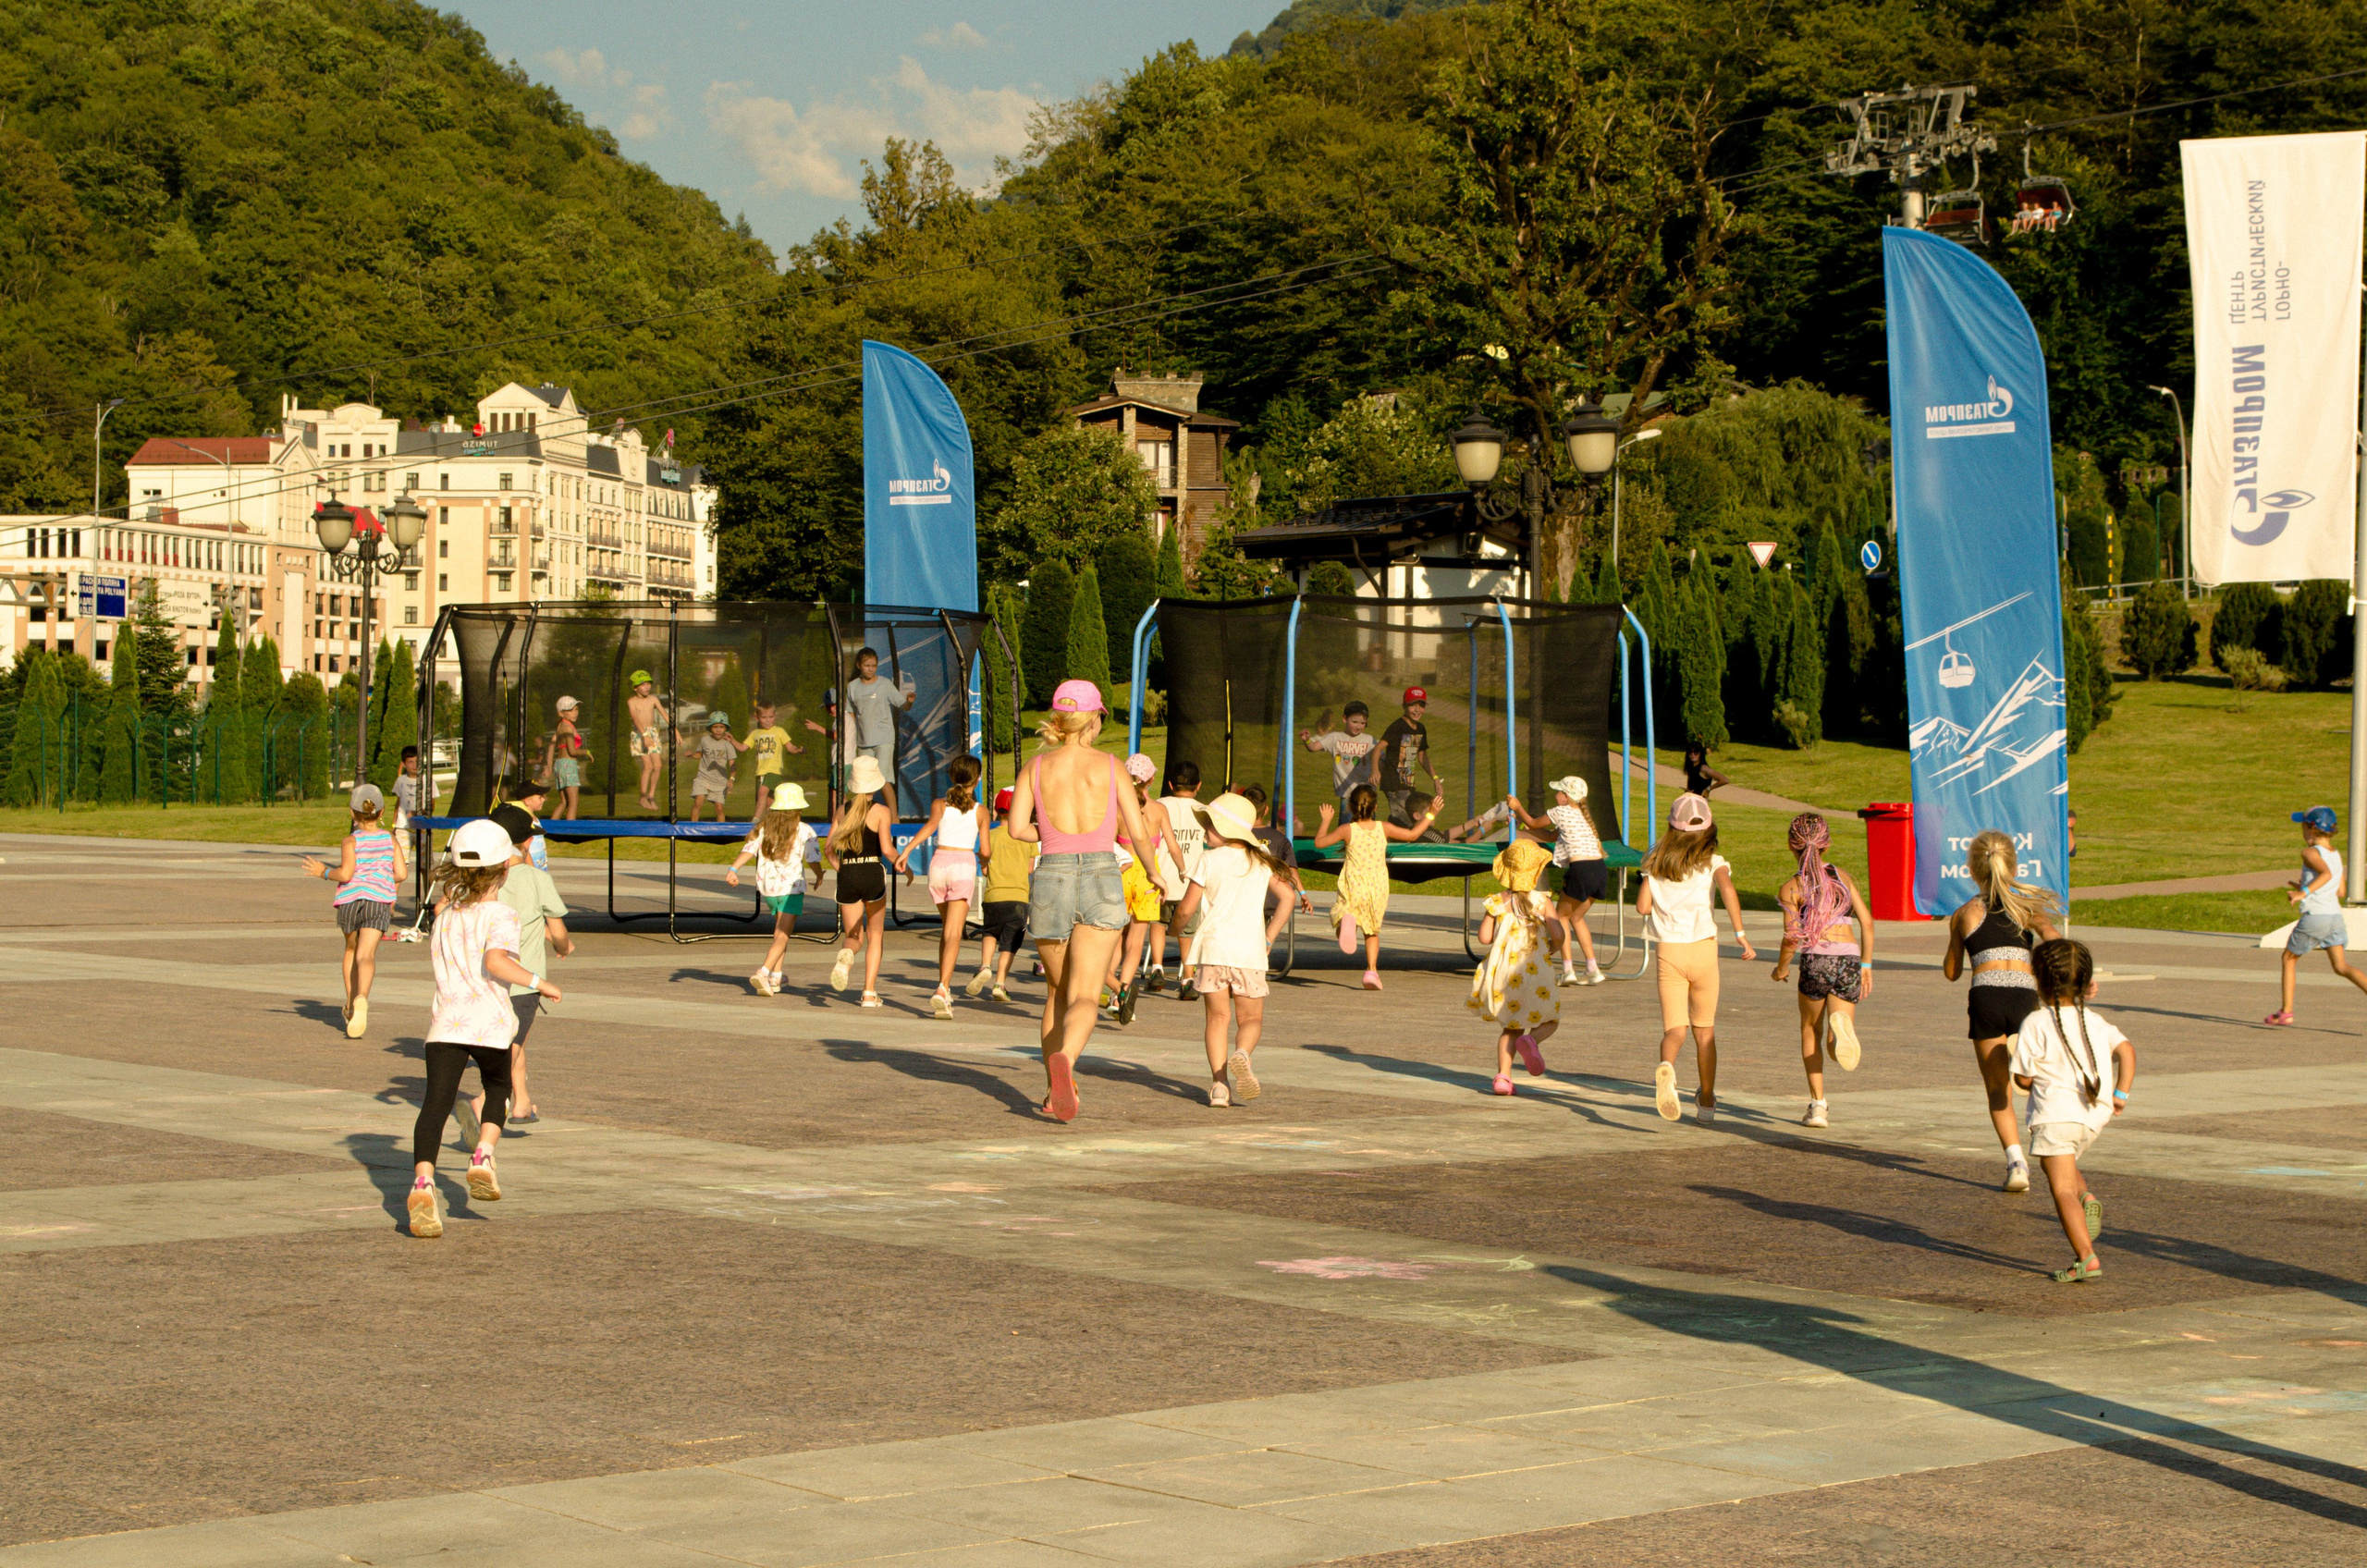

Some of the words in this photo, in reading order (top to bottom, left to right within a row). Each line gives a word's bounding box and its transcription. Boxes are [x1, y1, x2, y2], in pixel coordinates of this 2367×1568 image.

[80, 585, 104, 594] KRASYA
[1336, 741, 1368, 755] MARVEL
[1161, 828, 1200, 841] SITIVE
